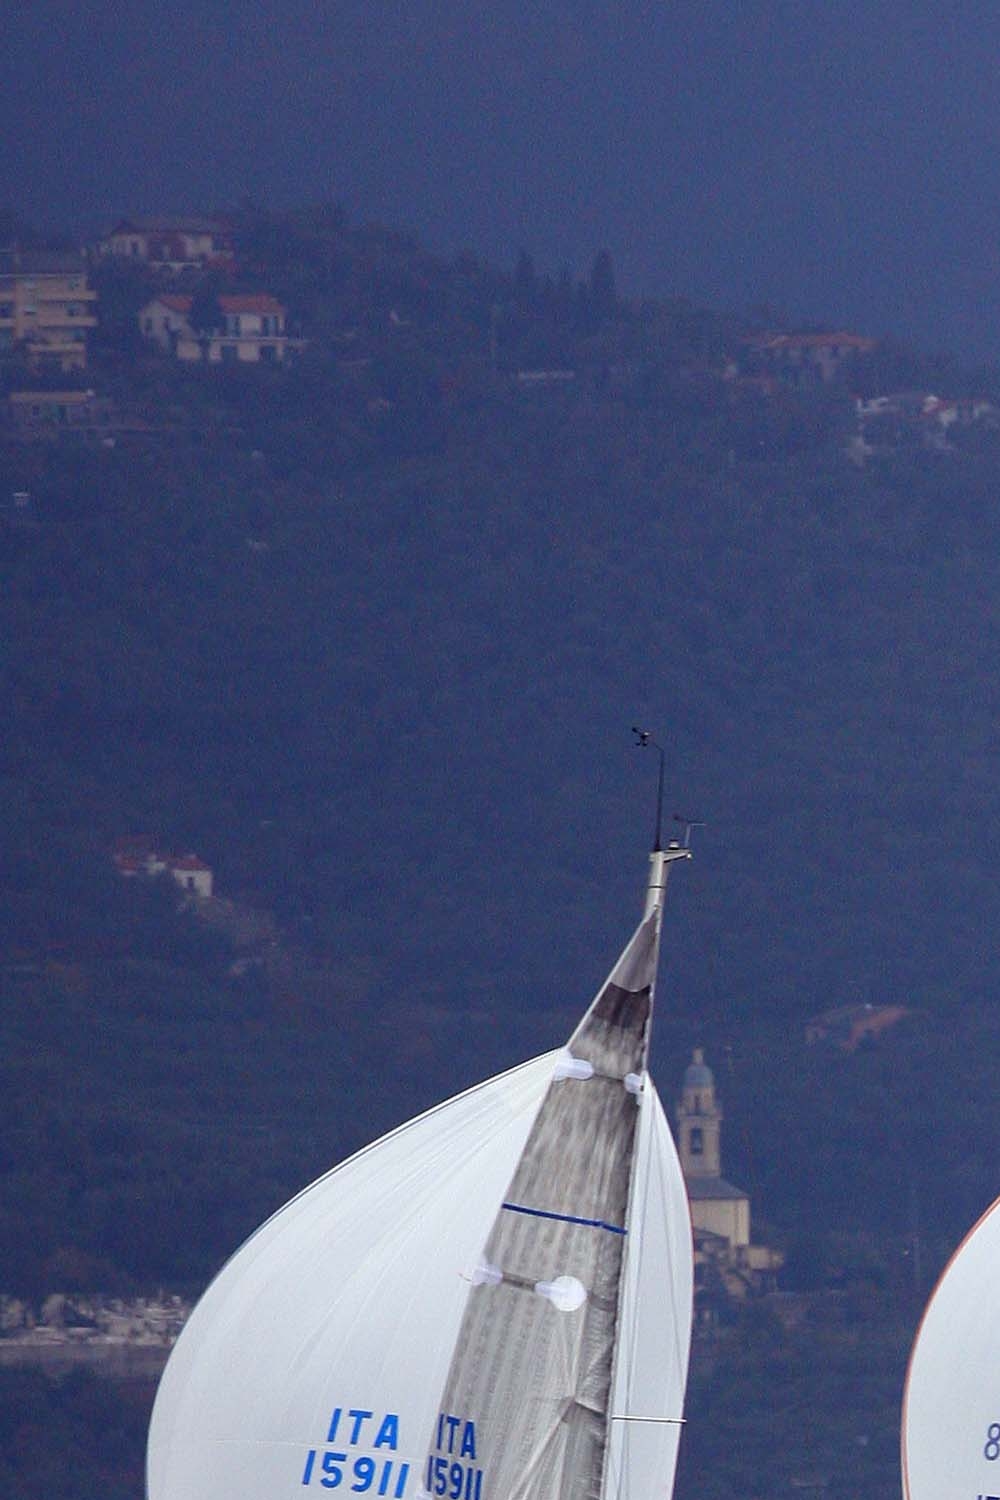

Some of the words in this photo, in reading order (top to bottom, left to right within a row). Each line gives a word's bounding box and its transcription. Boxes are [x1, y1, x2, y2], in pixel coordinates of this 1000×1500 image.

[327, 1408, 399, 1450] ITA
[436, 1413, 476, 1460] ITA
[302, 1450, 410, 1499] 15911
